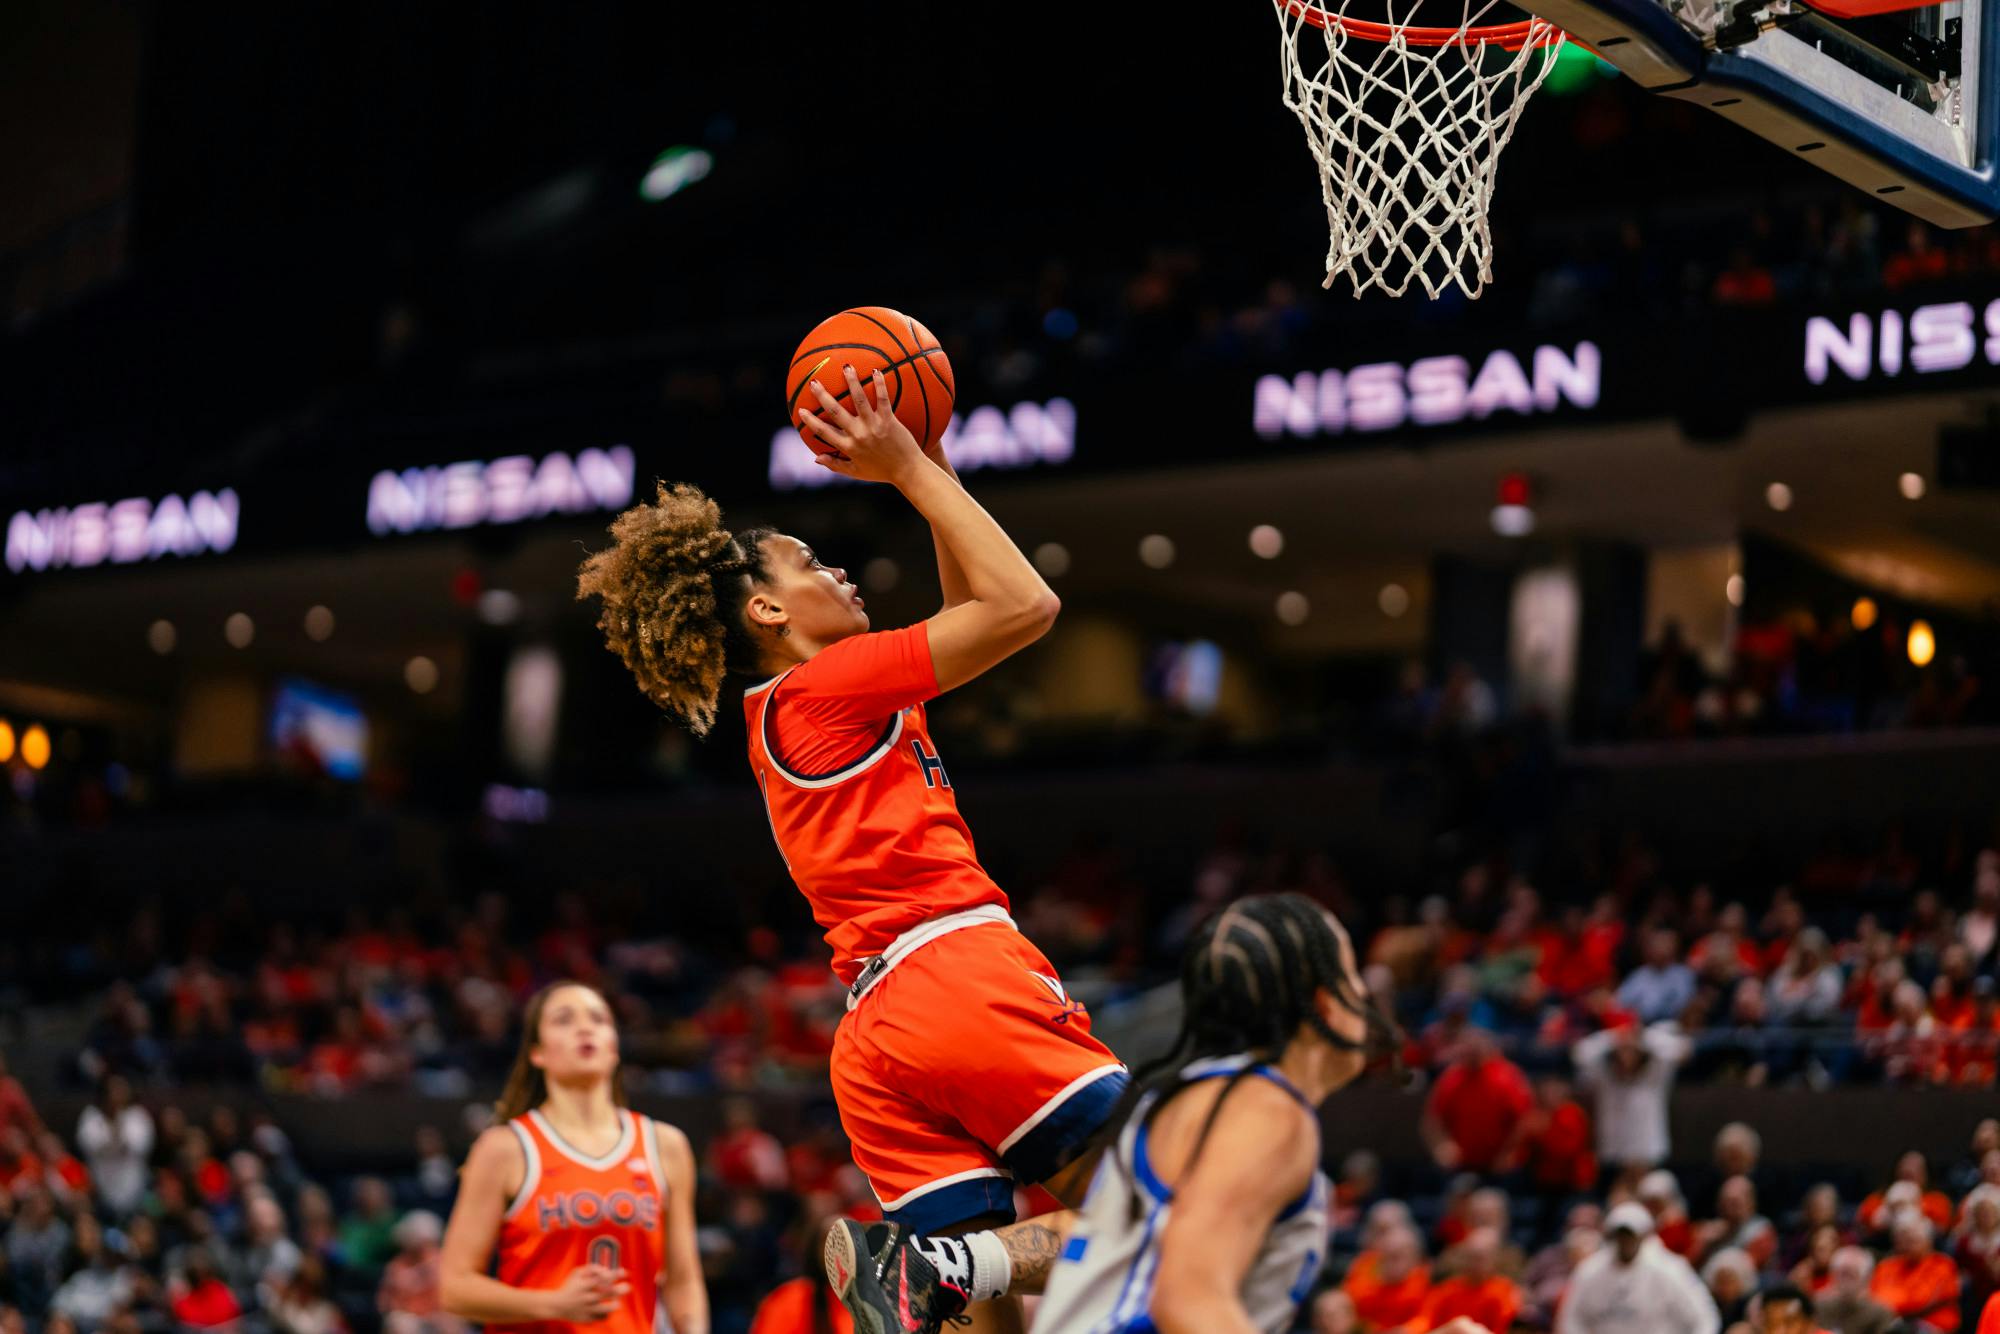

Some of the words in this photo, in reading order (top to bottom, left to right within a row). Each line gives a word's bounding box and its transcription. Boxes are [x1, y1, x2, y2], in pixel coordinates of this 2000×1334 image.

[1804, 298, 2000, 385] NIS
[1253, 340, 1600, 440] NISSAN
[5, 487, 240, 574] NISSAN
[366, 445, 636, 536] NISSAN
